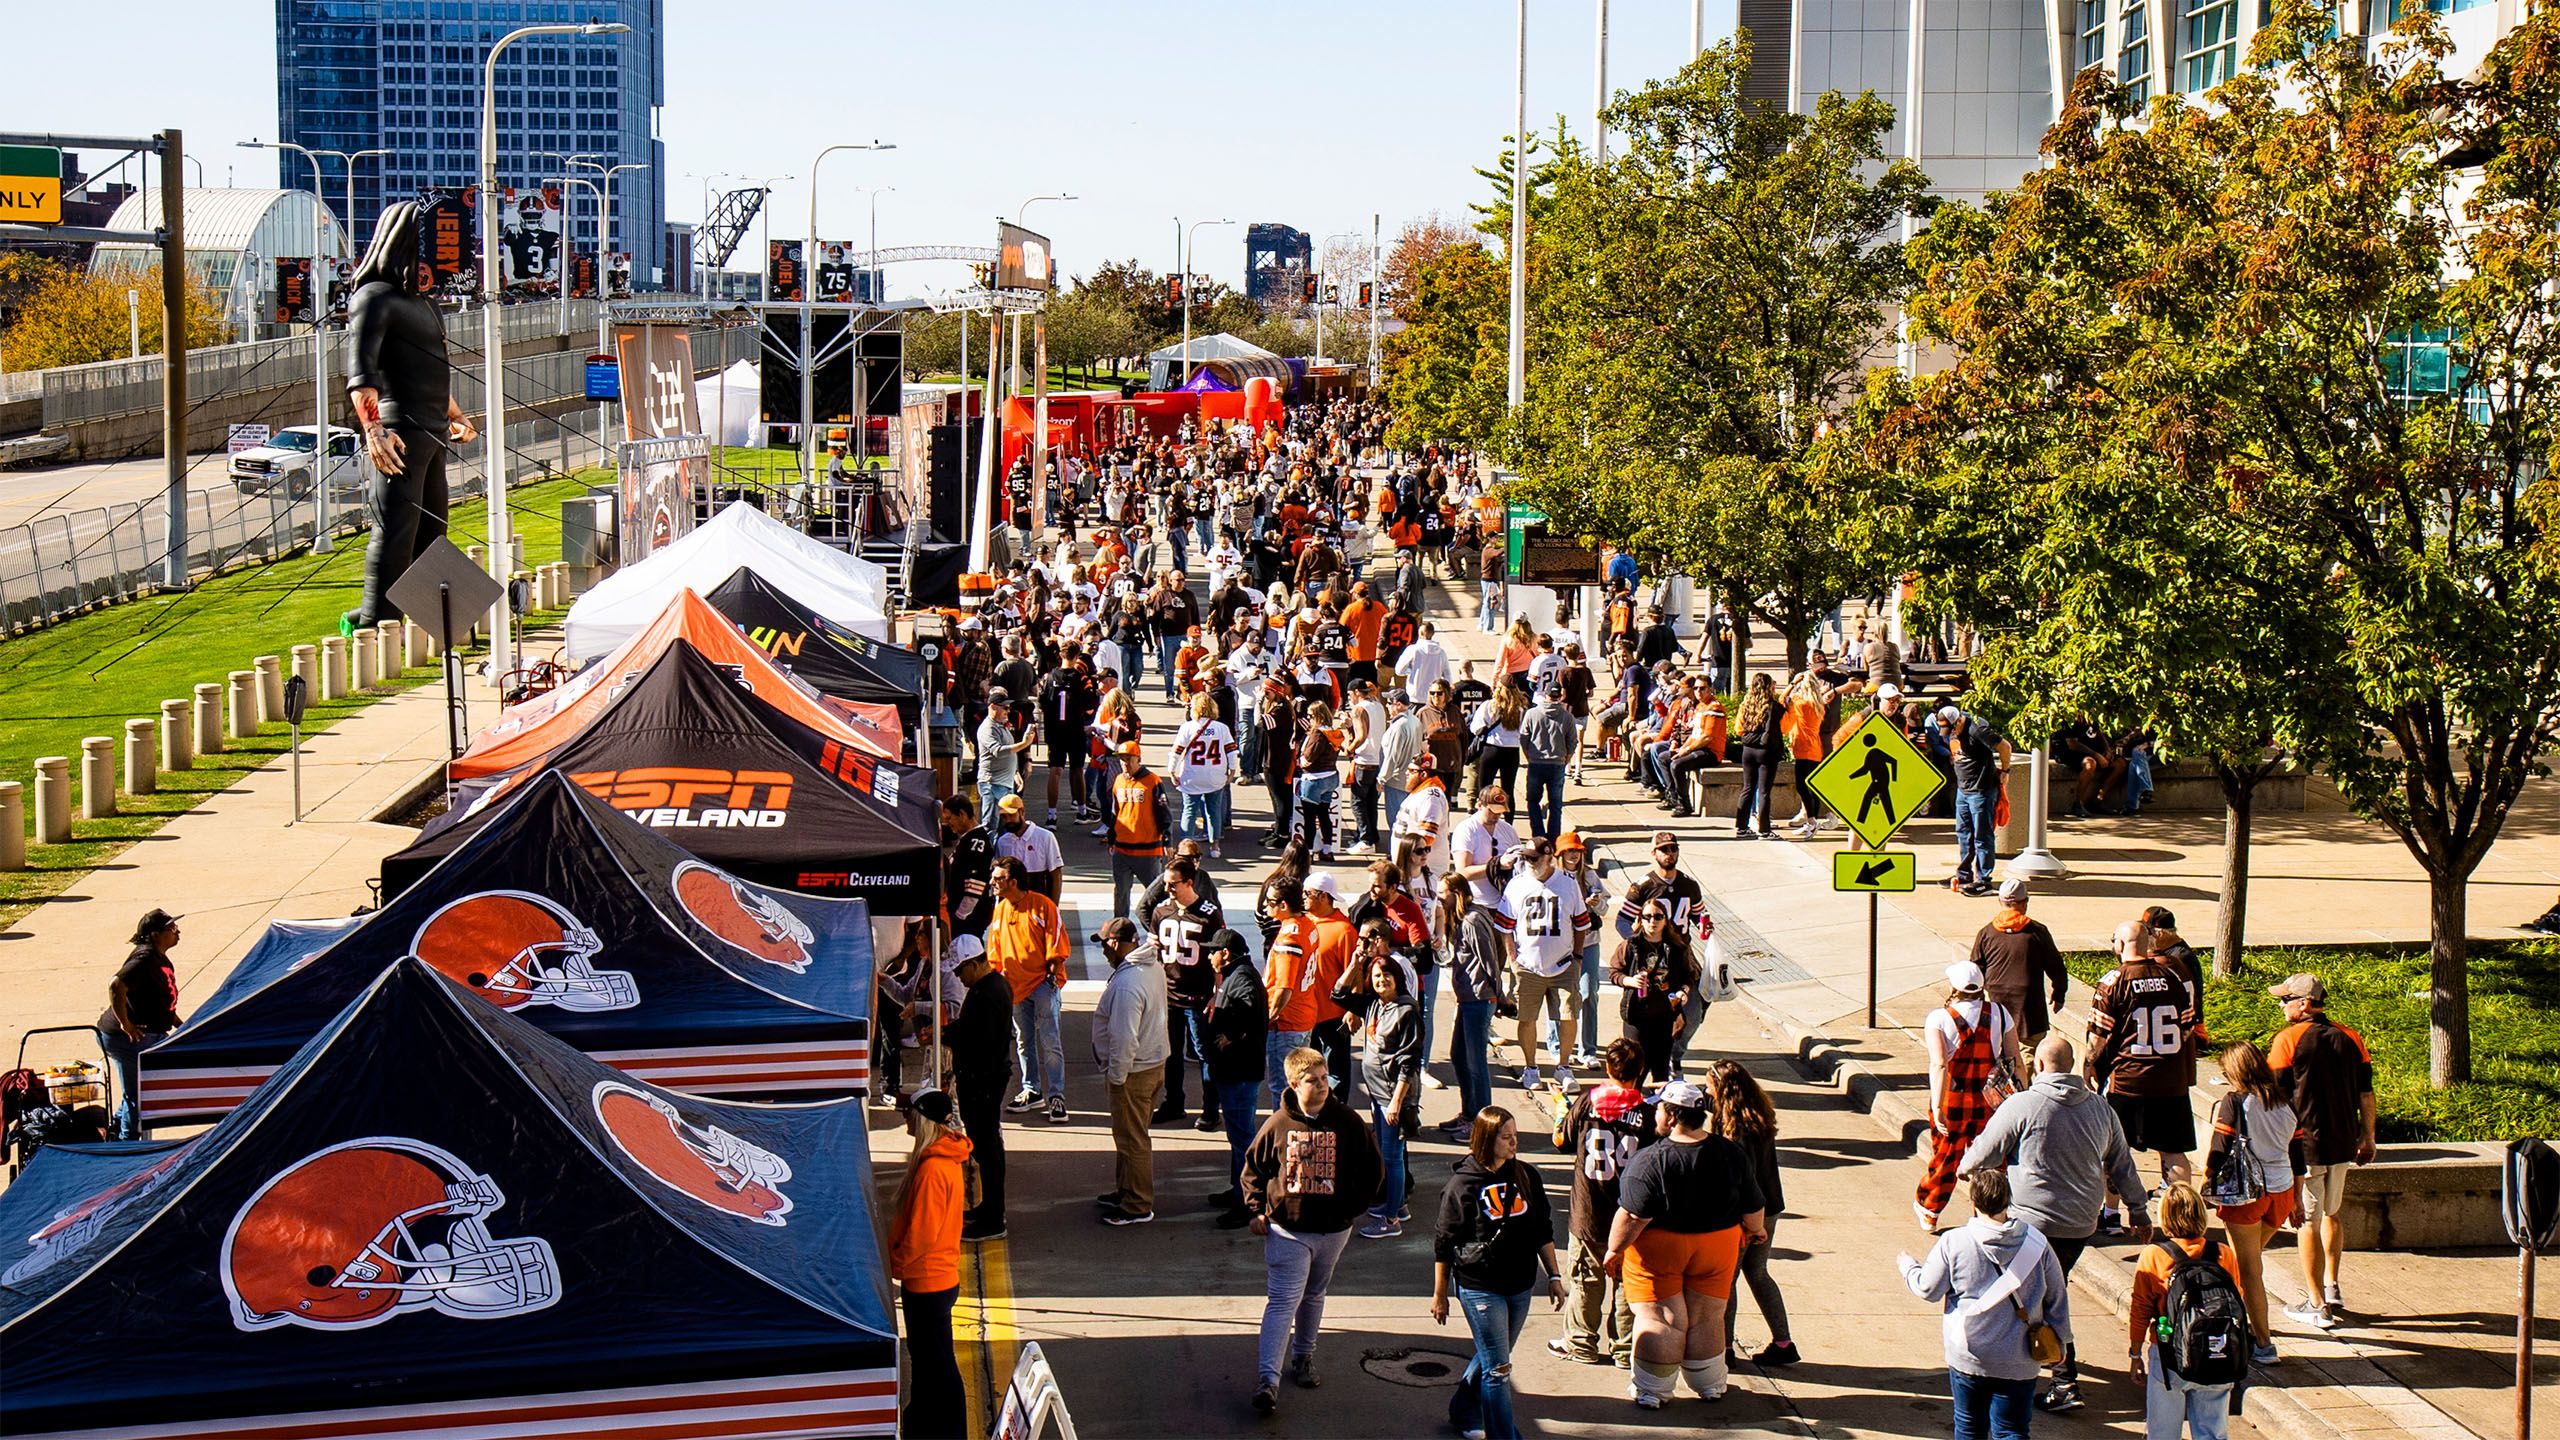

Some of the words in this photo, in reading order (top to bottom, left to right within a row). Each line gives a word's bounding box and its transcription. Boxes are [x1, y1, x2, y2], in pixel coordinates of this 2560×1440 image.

[0, 192, 46, 208] NLY
[436, 207, 460, 274] JERRY
[527, 246, 544, 274] 3
[778, 258, 793, 285] JOEL
[825, 273, 847, 290] 75
[287, 276, 302, 304] NICK
[1050, 416, 1073, 426] izon
[1012, 479, 1026, 492] 95
[1426, 518, 1439, 530] 24
[1114, 579, 1135, 598] 80
[1323, 636, 1344, 650] 24
[1389, 623, 1413, 647] 24
[1058, 690, 1066, 721] 1
[1462, 690, 1483, 699] WILSON
[1190, 739, 1222, 766] 24
[568, 767, 795, 811] ESPN
[624, 808, 788, 829] VELAND
[971, 838, 985, 851] 73
[797, 873, 849, 887] ESPN
[1525, 895, 1562, 937] 21
[1157, 919, 1203, 966] 95
[2132, 978, 2169, 994] CRIBBS
[2130, 1005, 2182, 1055] 16
[1584, 1128, 1640, 1181] 84
